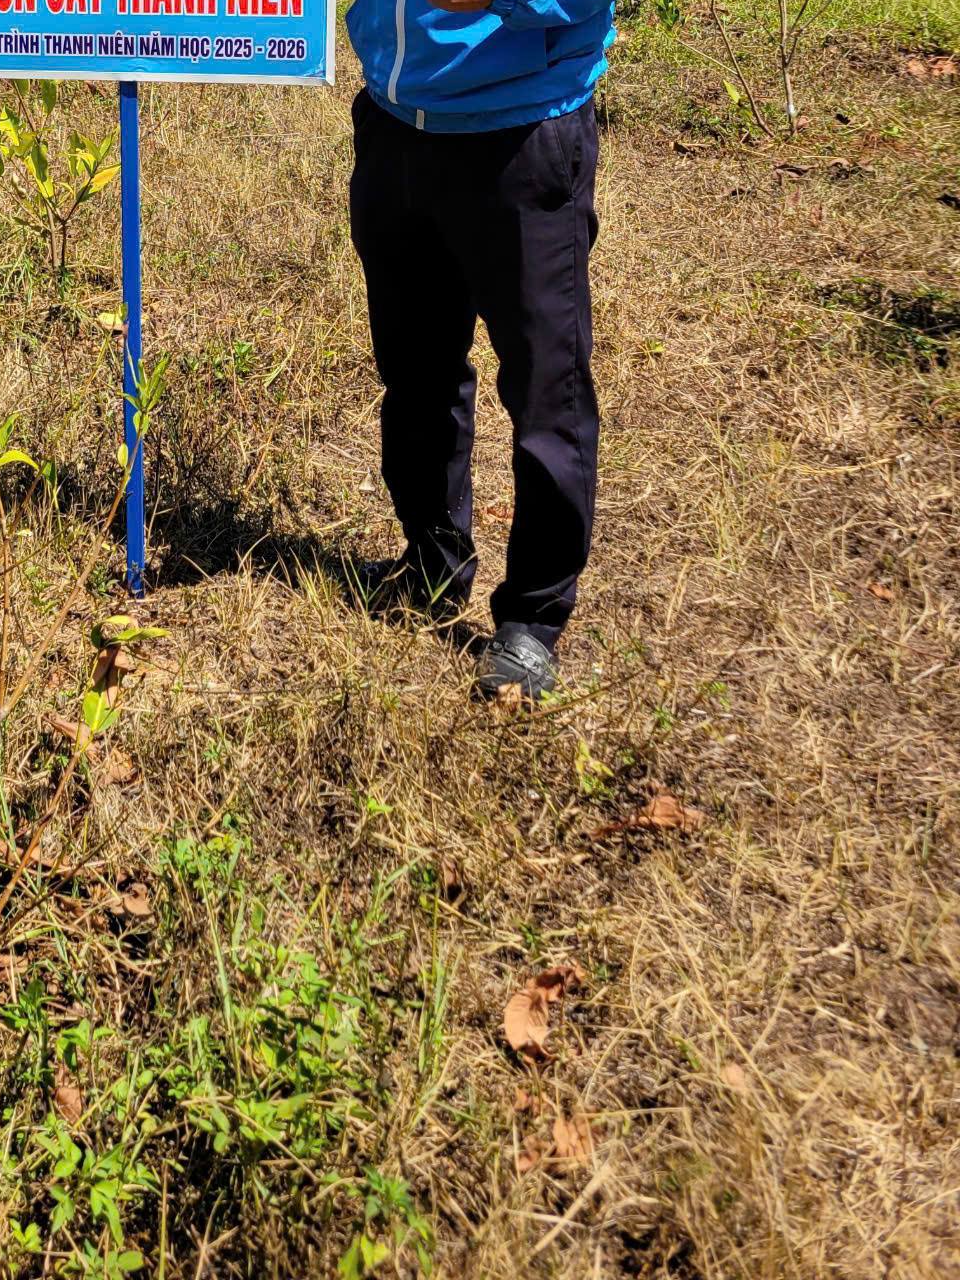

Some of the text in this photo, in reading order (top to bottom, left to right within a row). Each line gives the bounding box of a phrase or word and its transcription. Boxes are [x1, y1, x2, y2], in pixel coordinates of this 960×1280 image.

[44, 34, 94, 55] THANH
[97, 32, 135, 56] NIÊN
[139, 32, 175, 57] NĂM
[179, 37, 210, 62] HỌC
[214, 38, 252, 58] 2025
[267, 39, 306, 59] 2026
